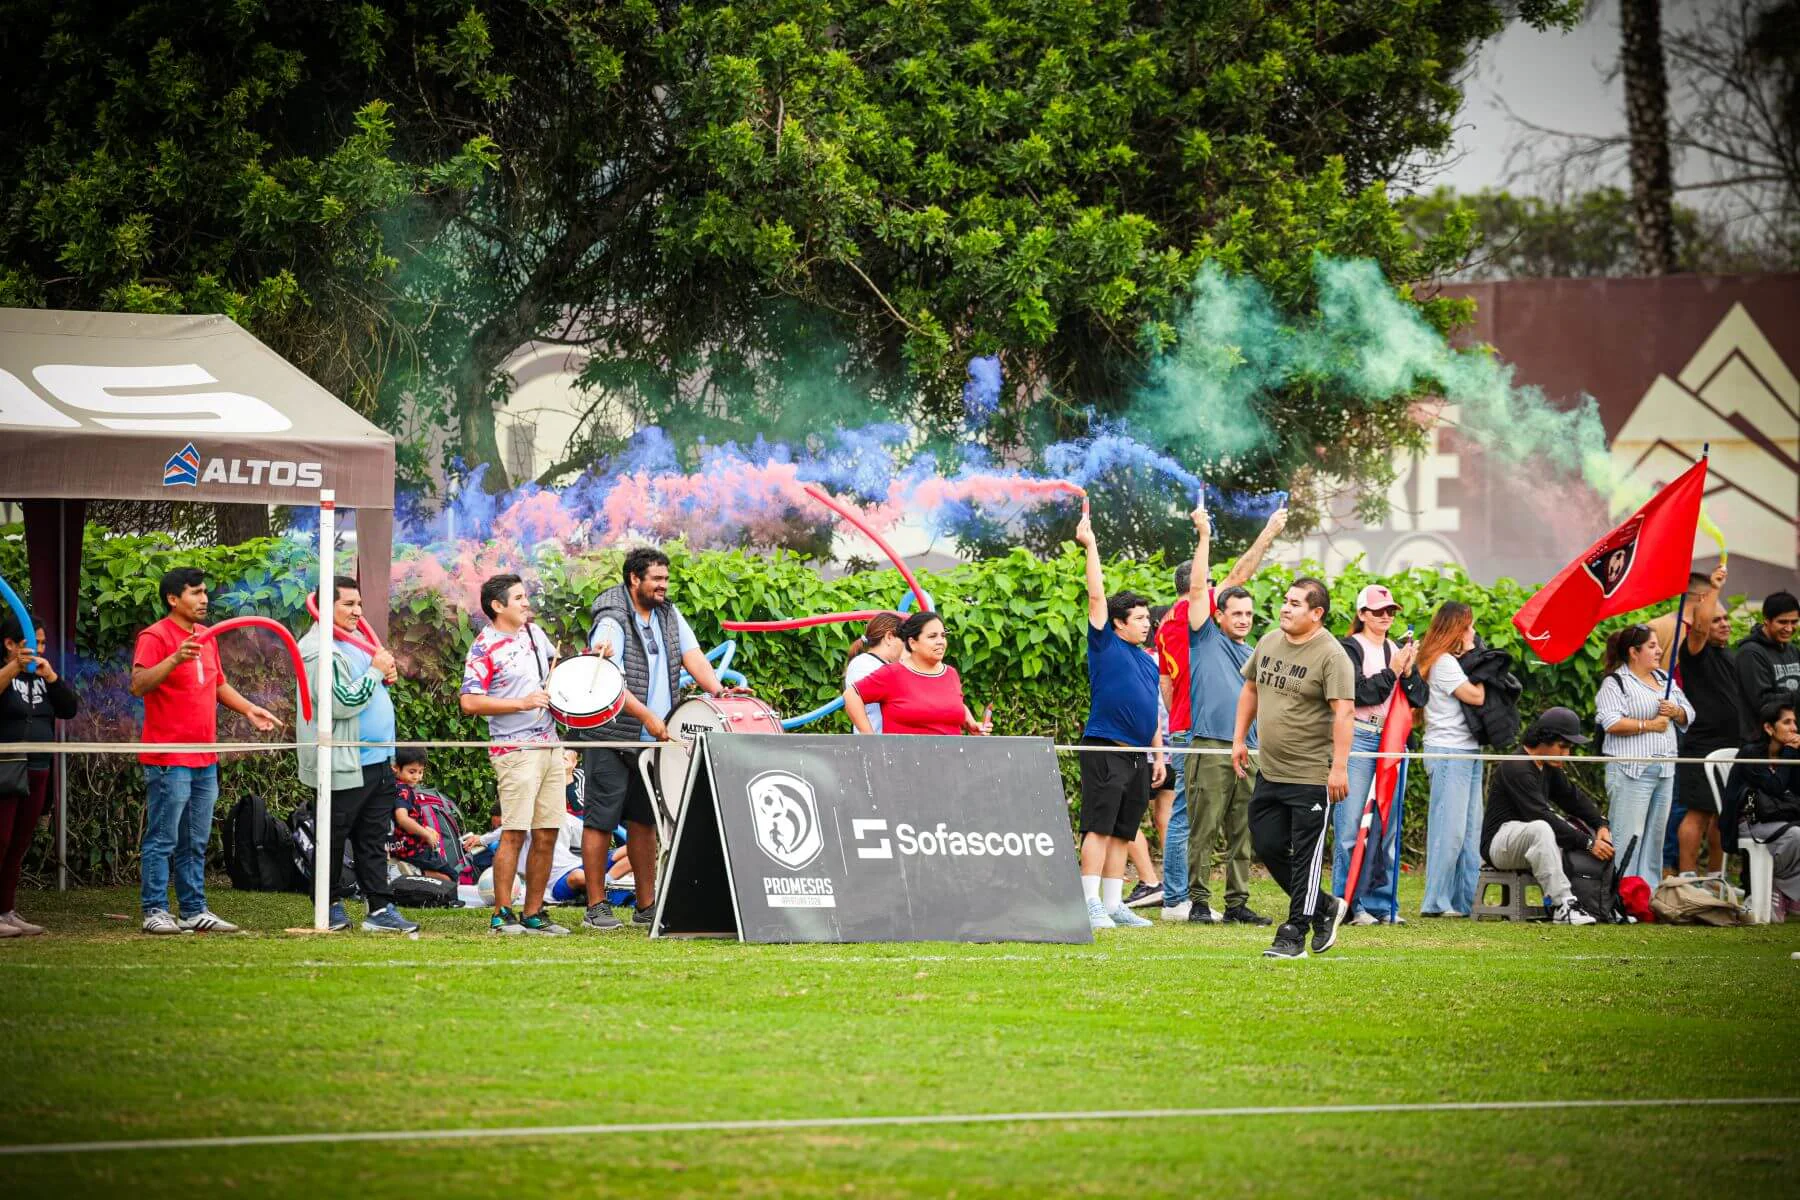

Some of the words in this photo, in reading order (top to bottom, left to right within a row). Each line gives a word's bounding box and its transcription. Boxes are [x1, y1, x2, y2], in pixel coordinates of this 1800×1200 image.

[200, 457, 323, 488] ALTOS
[895, 822, 1055, 857] Sofascore
[763, 877, 834, 895] PROMESAS
